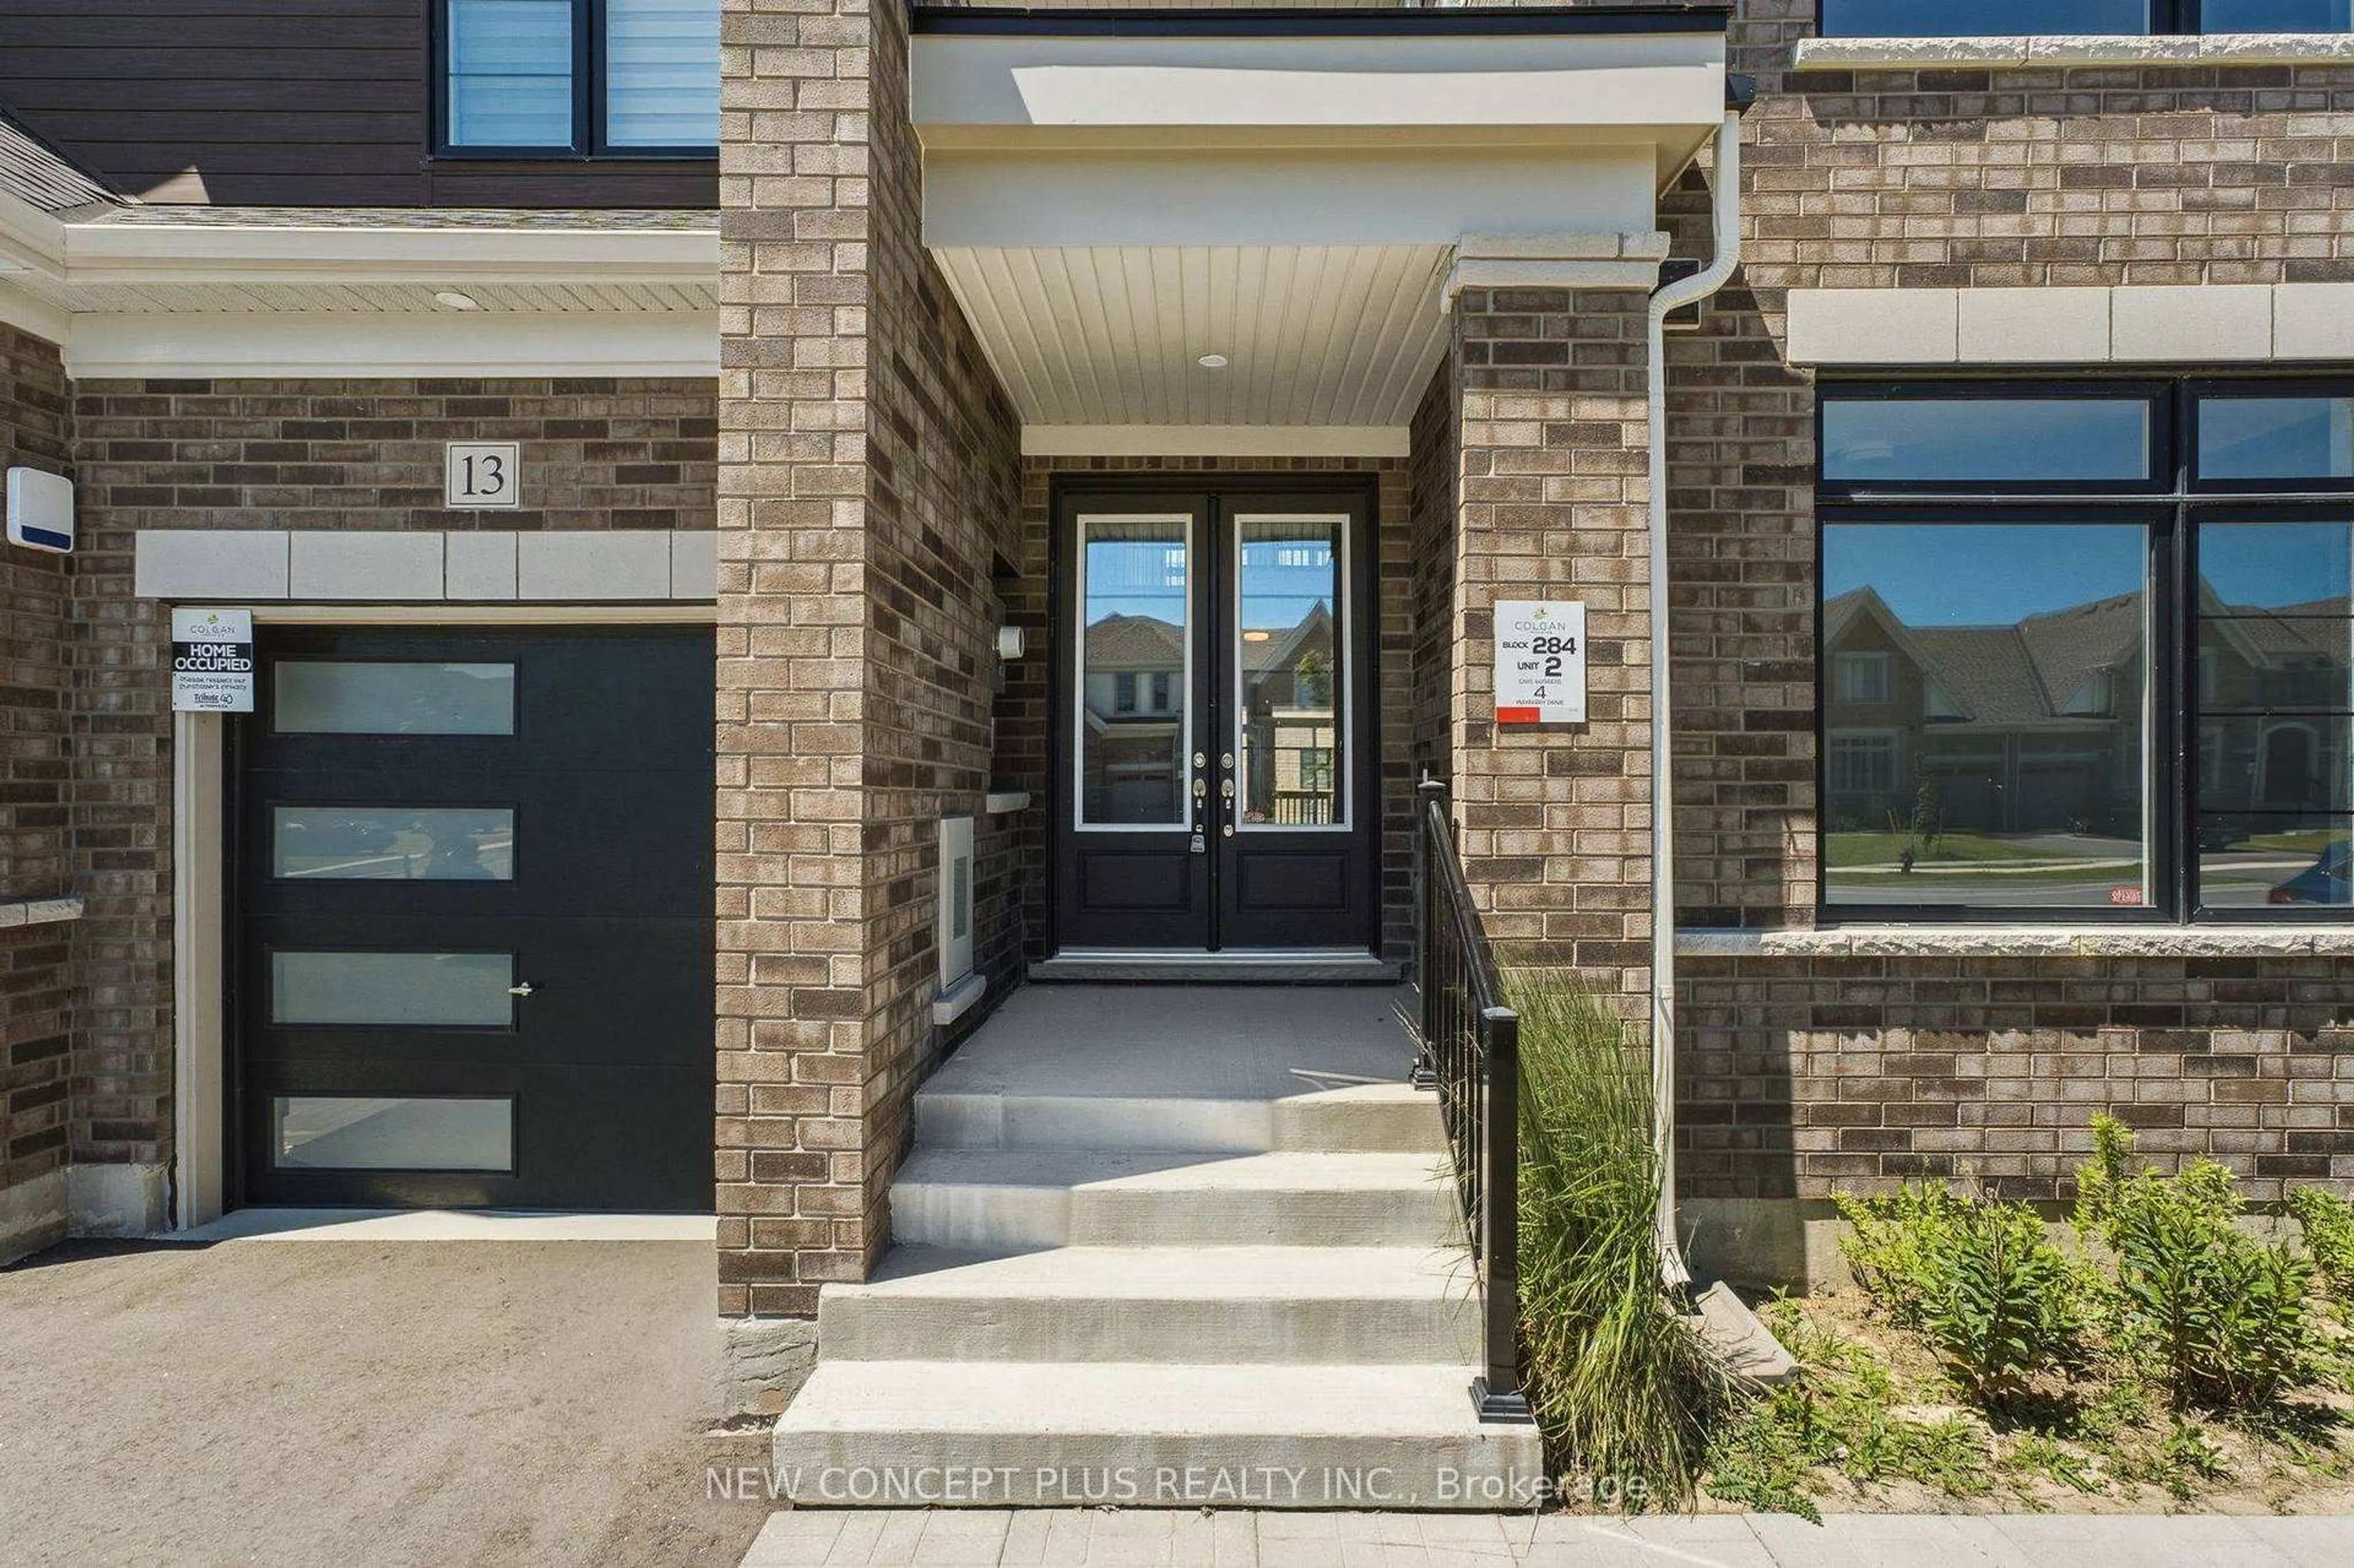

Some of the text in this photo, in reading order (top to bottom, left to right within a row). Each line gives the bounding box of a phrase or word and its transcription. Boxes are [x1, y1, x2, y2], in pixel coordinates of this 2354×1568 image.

[462, 455, 504, 495] 13
[190, 625, 235, 634] COLGAN
[1514, 622, 1566, 631] COLGAN
[190, 644, 237, 657] HOME
[1533, 636, 1577, 654] 284
[175, 657, 251, 671] OCCUPIED
[1545, 657, 1562, 677] 2
[1534, 685, 1546, 699] 4
